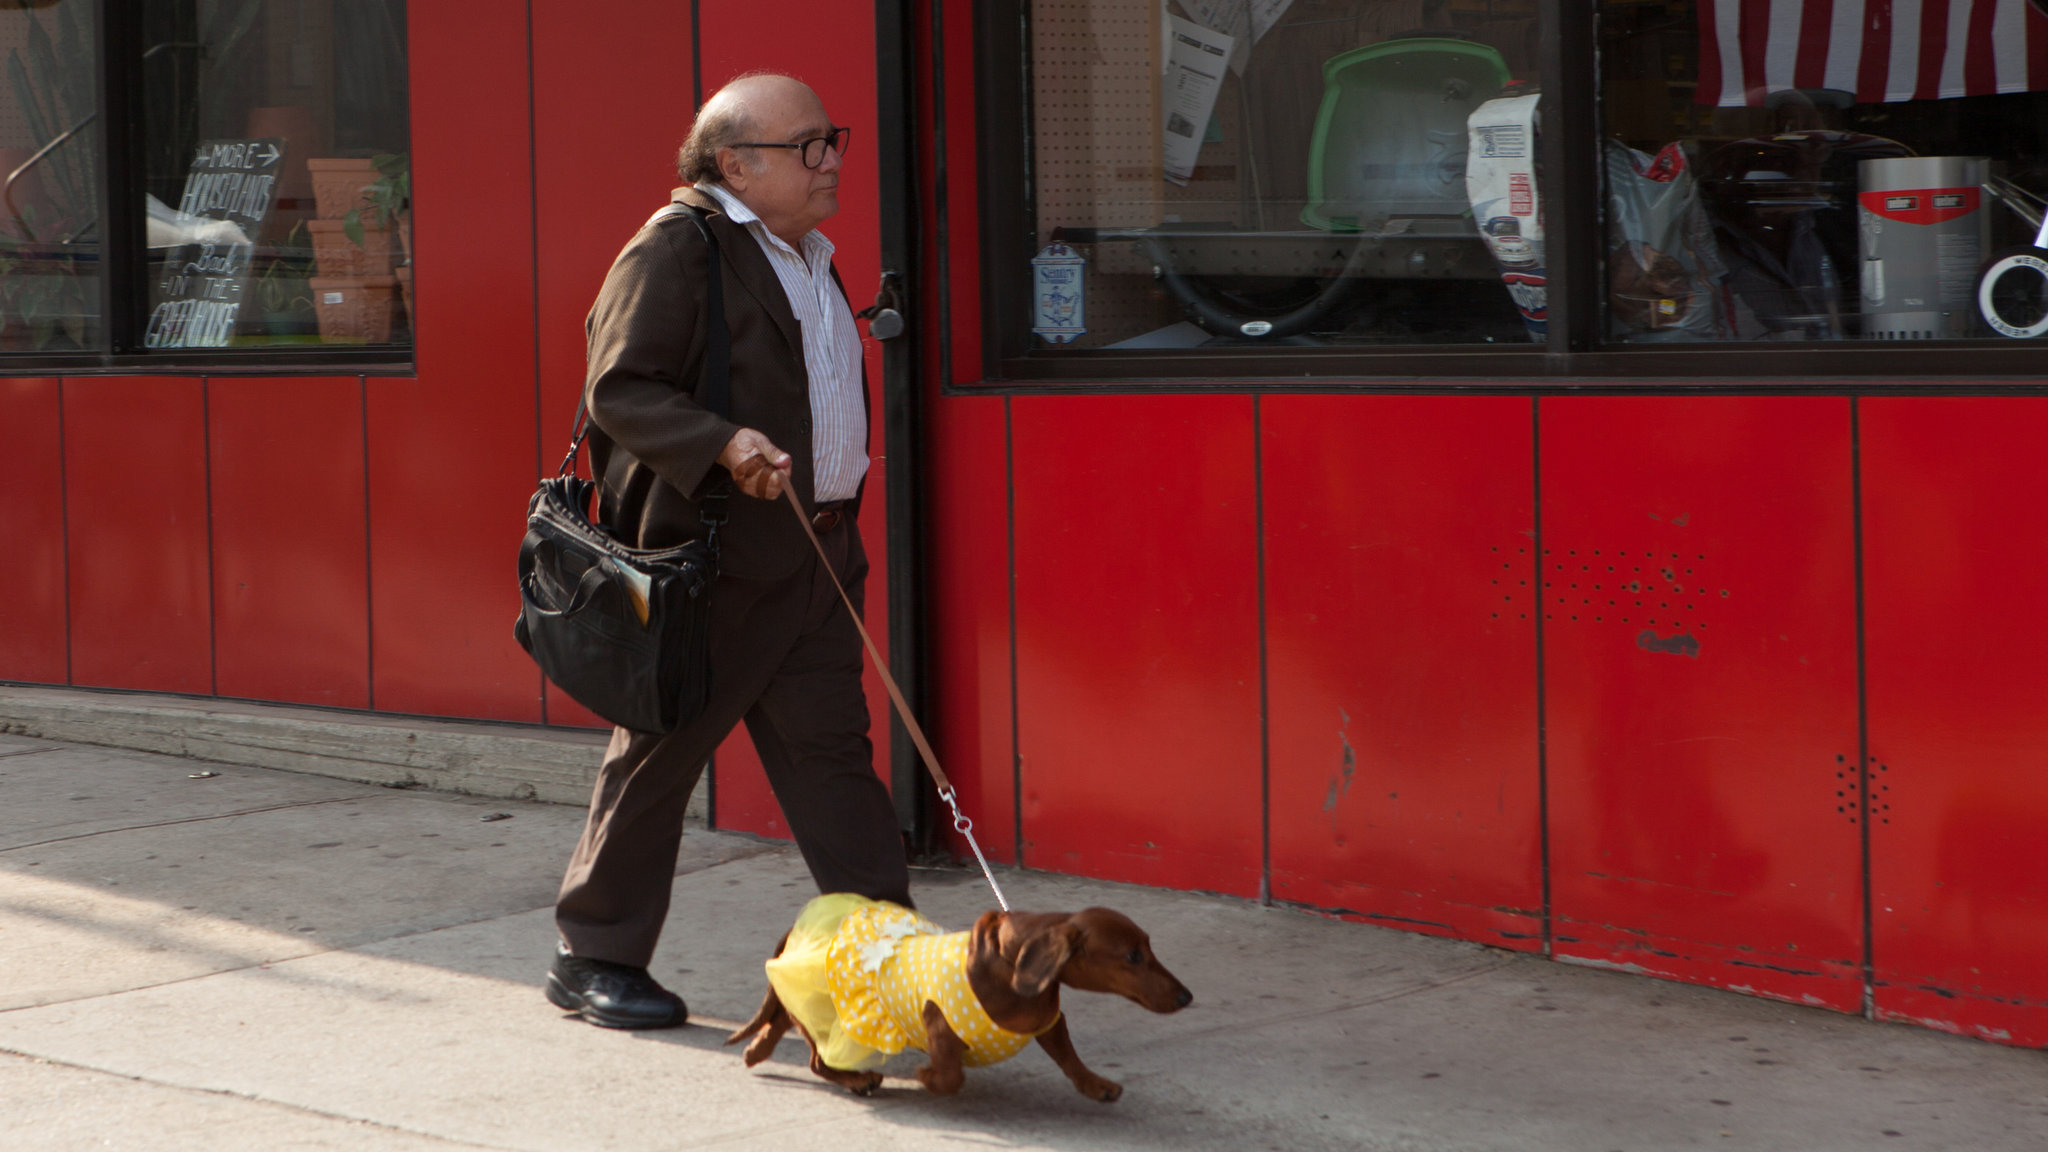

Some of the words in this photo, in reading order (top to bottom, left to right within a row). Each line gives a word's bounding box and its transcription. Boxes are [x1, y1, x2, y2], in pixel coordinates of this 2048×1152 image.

[208, 143, 260, 169] MORE
[176, 172, 275, 222] HOUSEPLANTS
[166, 275, 192, 296] IN
[203, 277, 234, 299] THE
[144, 298, 240, 348] GREENHOUSE
